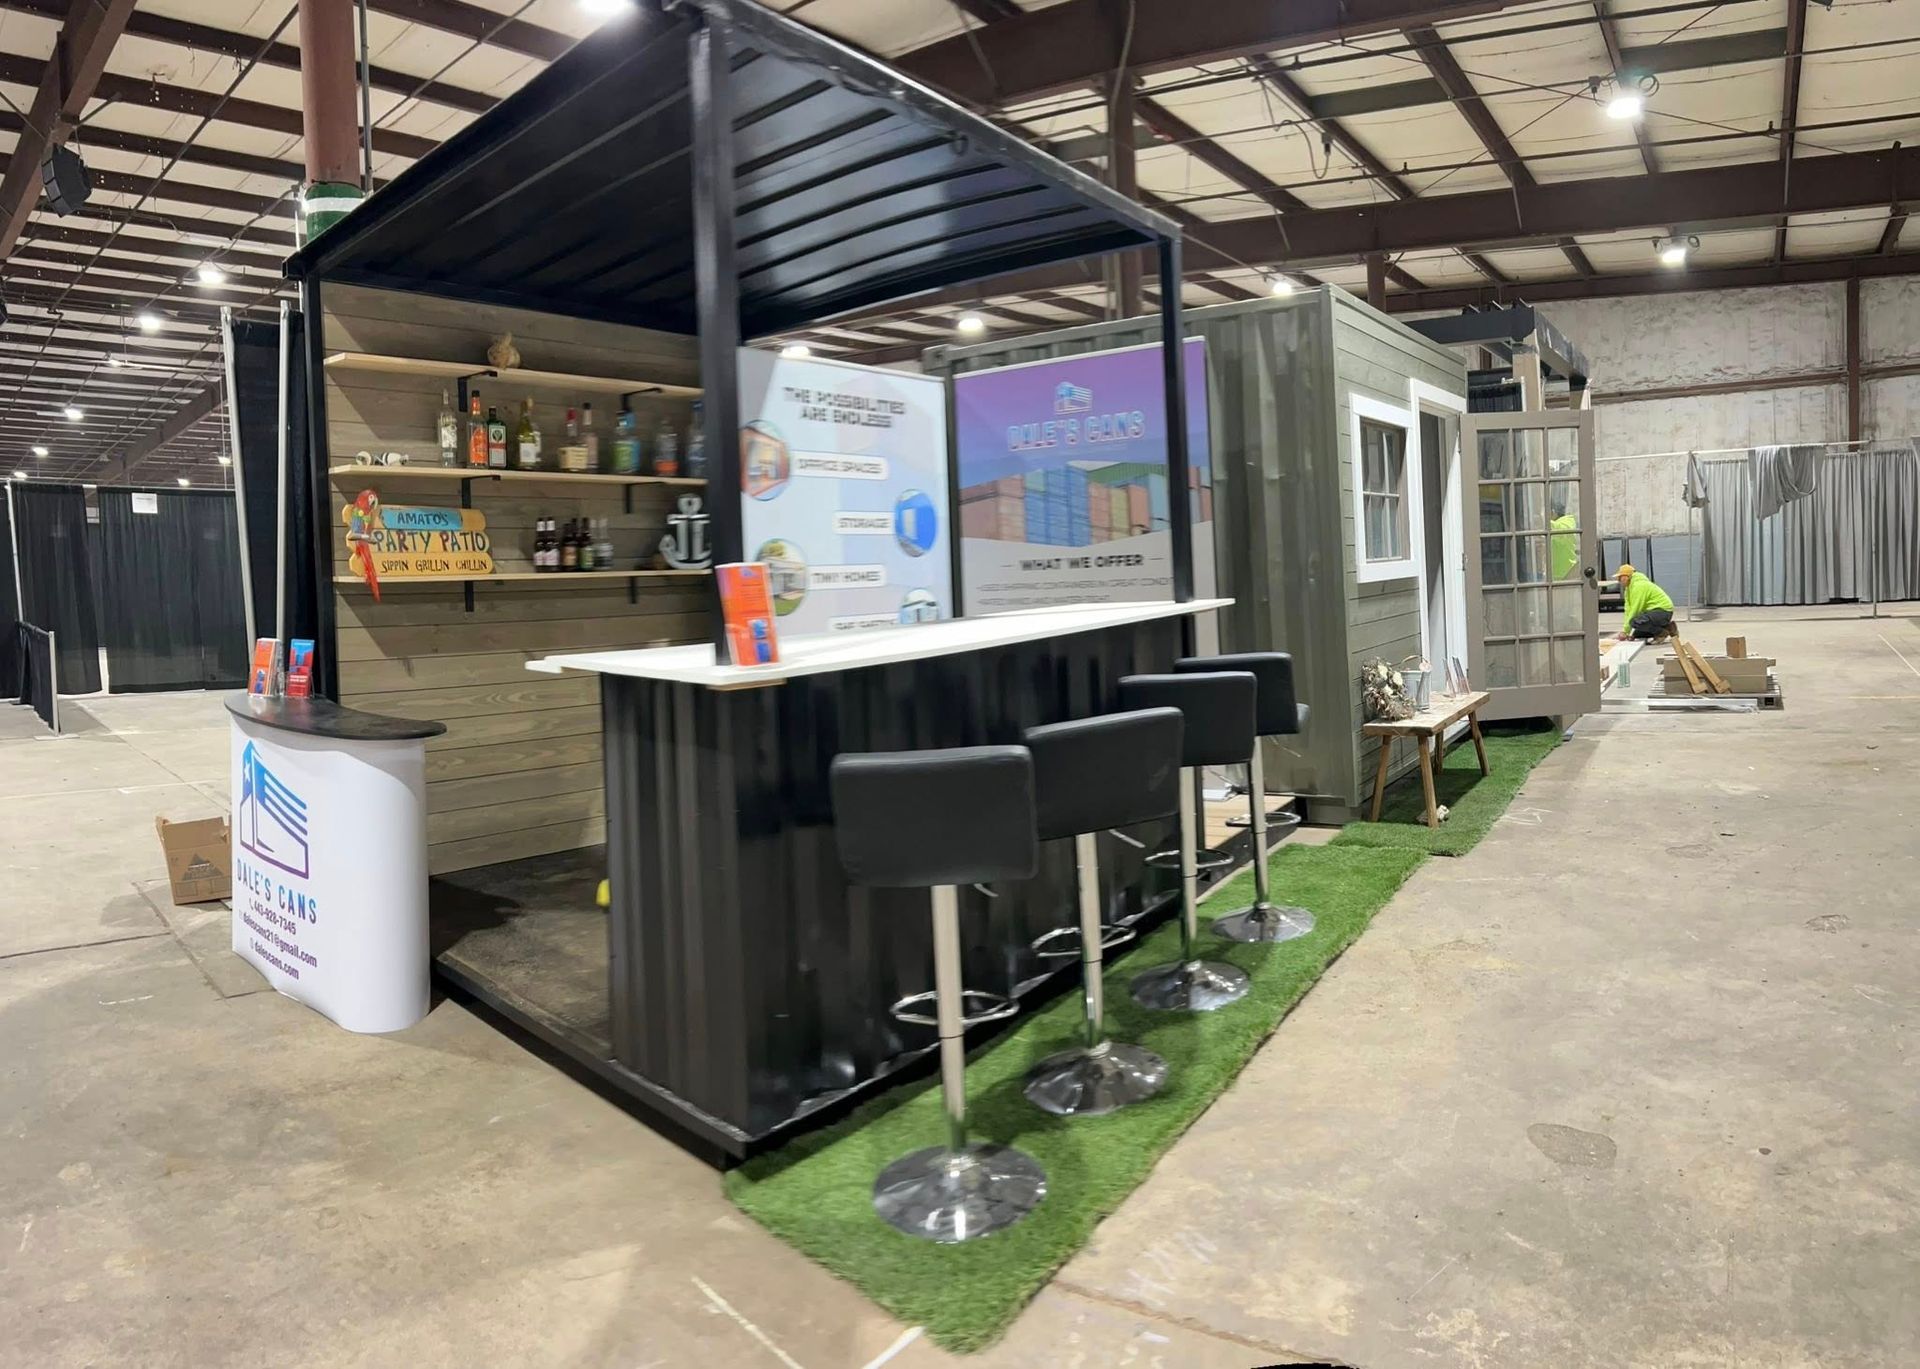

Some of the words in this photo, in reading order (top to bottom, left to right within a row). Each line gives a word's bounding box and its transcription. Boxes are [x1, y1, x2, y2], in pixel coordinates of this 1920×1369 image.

[783, 386, 811, 405] THE
[817, 391, 906, 414] POSSIBILITIES
[800, 406, 828, 423] ARE
[833, 408, 892, 429] ENDLESS
[1007, 417, 1081, 451] DALE'S
[1084, 410, 1146, 444] CANS
[397, 511, 450, 527] AMATO'S
[373, 529, 432, 553] PARTY
[439, 529, 488, 552] PATIO
[380, 558, 409, 574] SIPPIN
[415, 559, 450, 572] GRILLIN
[455, 559, 488, 571] CHILLIN
[1019, 557, 1062, 572] WHAT
[1067, 556, 1090, 569] WE
[1094, 553, 1145, 569] OFFER
[237, 858, 272, 902] DALE'S
[278, 885, 317, 925] CANS
[254, 940, 300, 980] dalescans.com
